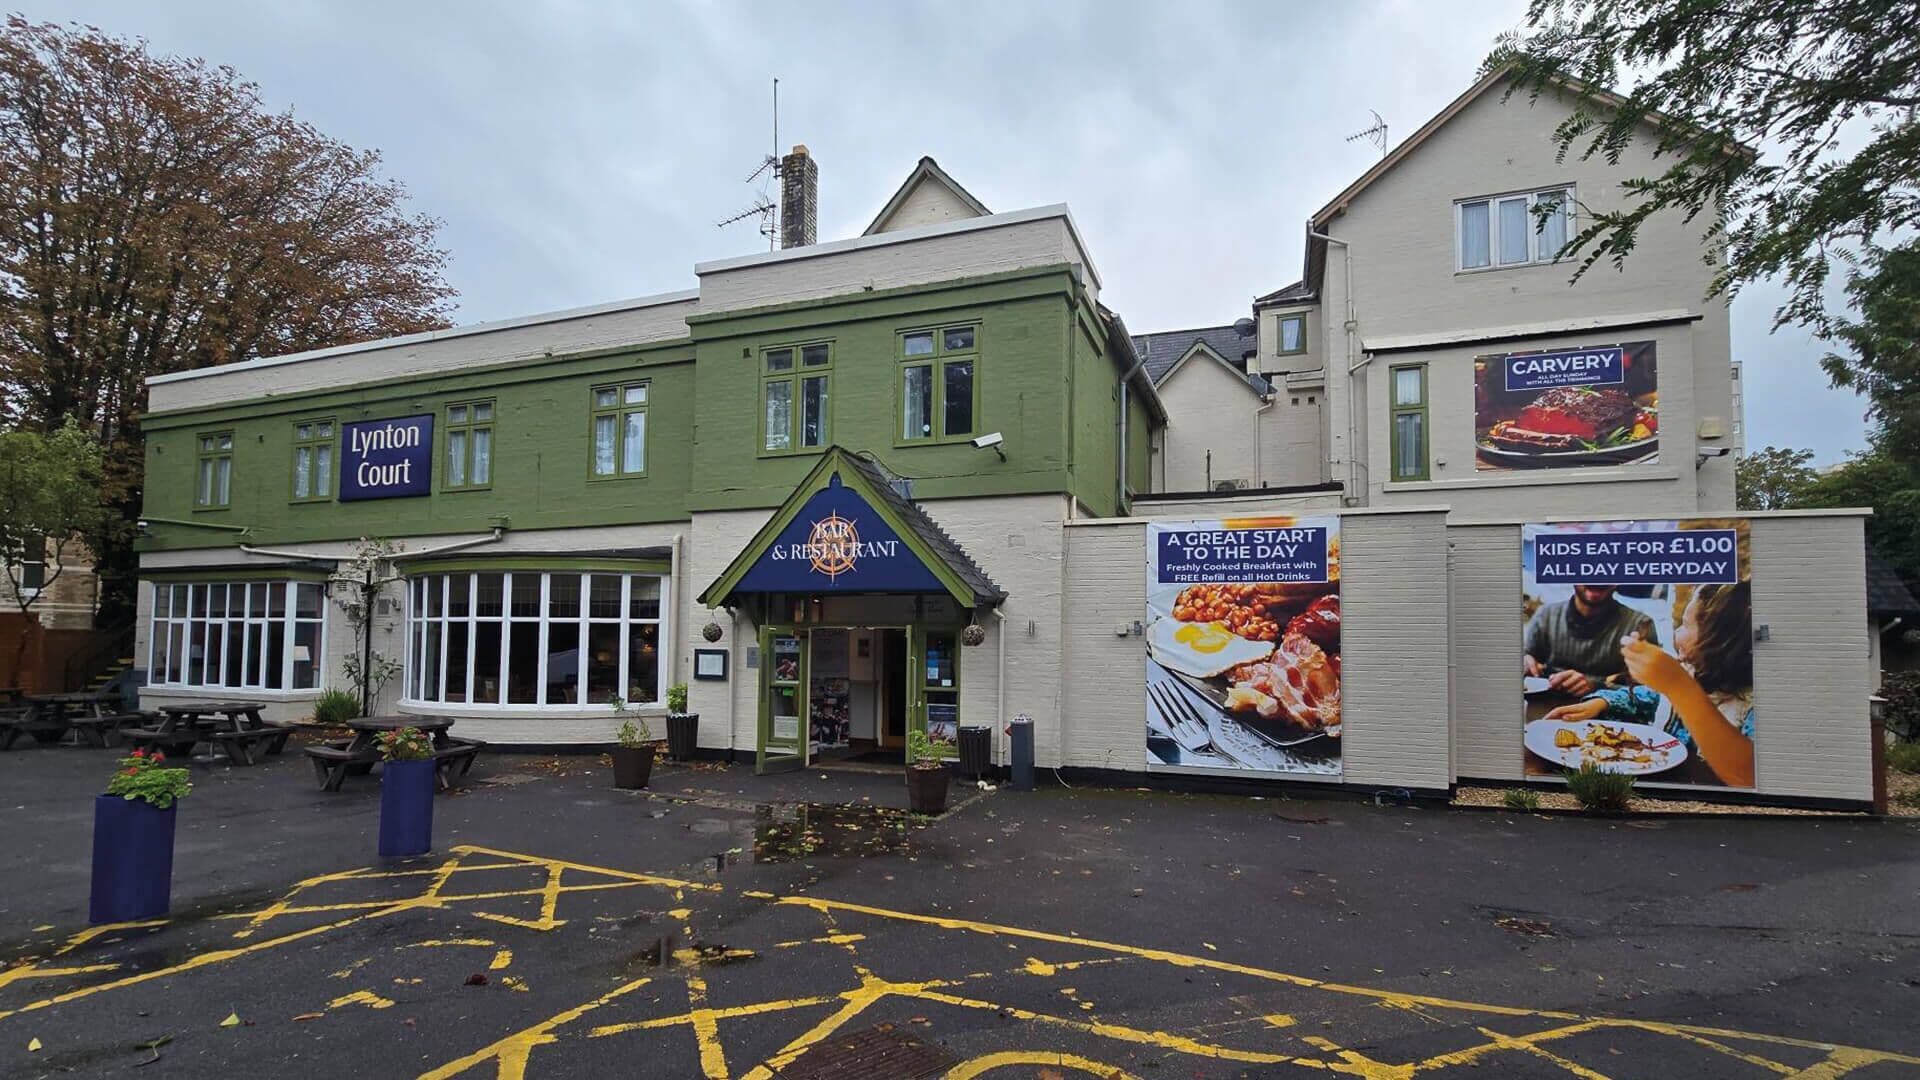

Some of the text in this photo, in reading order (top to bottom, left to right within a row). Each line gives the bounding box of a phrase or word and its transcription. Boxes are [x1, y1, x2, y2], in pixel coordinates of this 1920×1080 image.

[1512, 353, 1614, 375] CARVERY
[351, 423, 419, 459] Lynton
[357, 458, 411, 487] Court
[816, 521, 849, 539] BAR
[1167, 529, 1317, 546] A GREAT START
[771, 540, 899, 560] & RESTAURANT
[1182, 544, 1298, 560] TO THE DAY
[1539, 537, 1732, 556] KIDS EAT FOR £1.00
[1166, 560, 1317, 573] Freshly Cooked Breakfast with
[1542, 562, 1727, 576] ALL DAY EVERYDAY
[1175, 574, 1200, 582] FREE
[1201, 573, 1225, 581] Refill
[1241, 572, 1254, 581] all
[1256, 573, 1274, 581] Hot
[1277, 572, 1311, 581] Drinks
